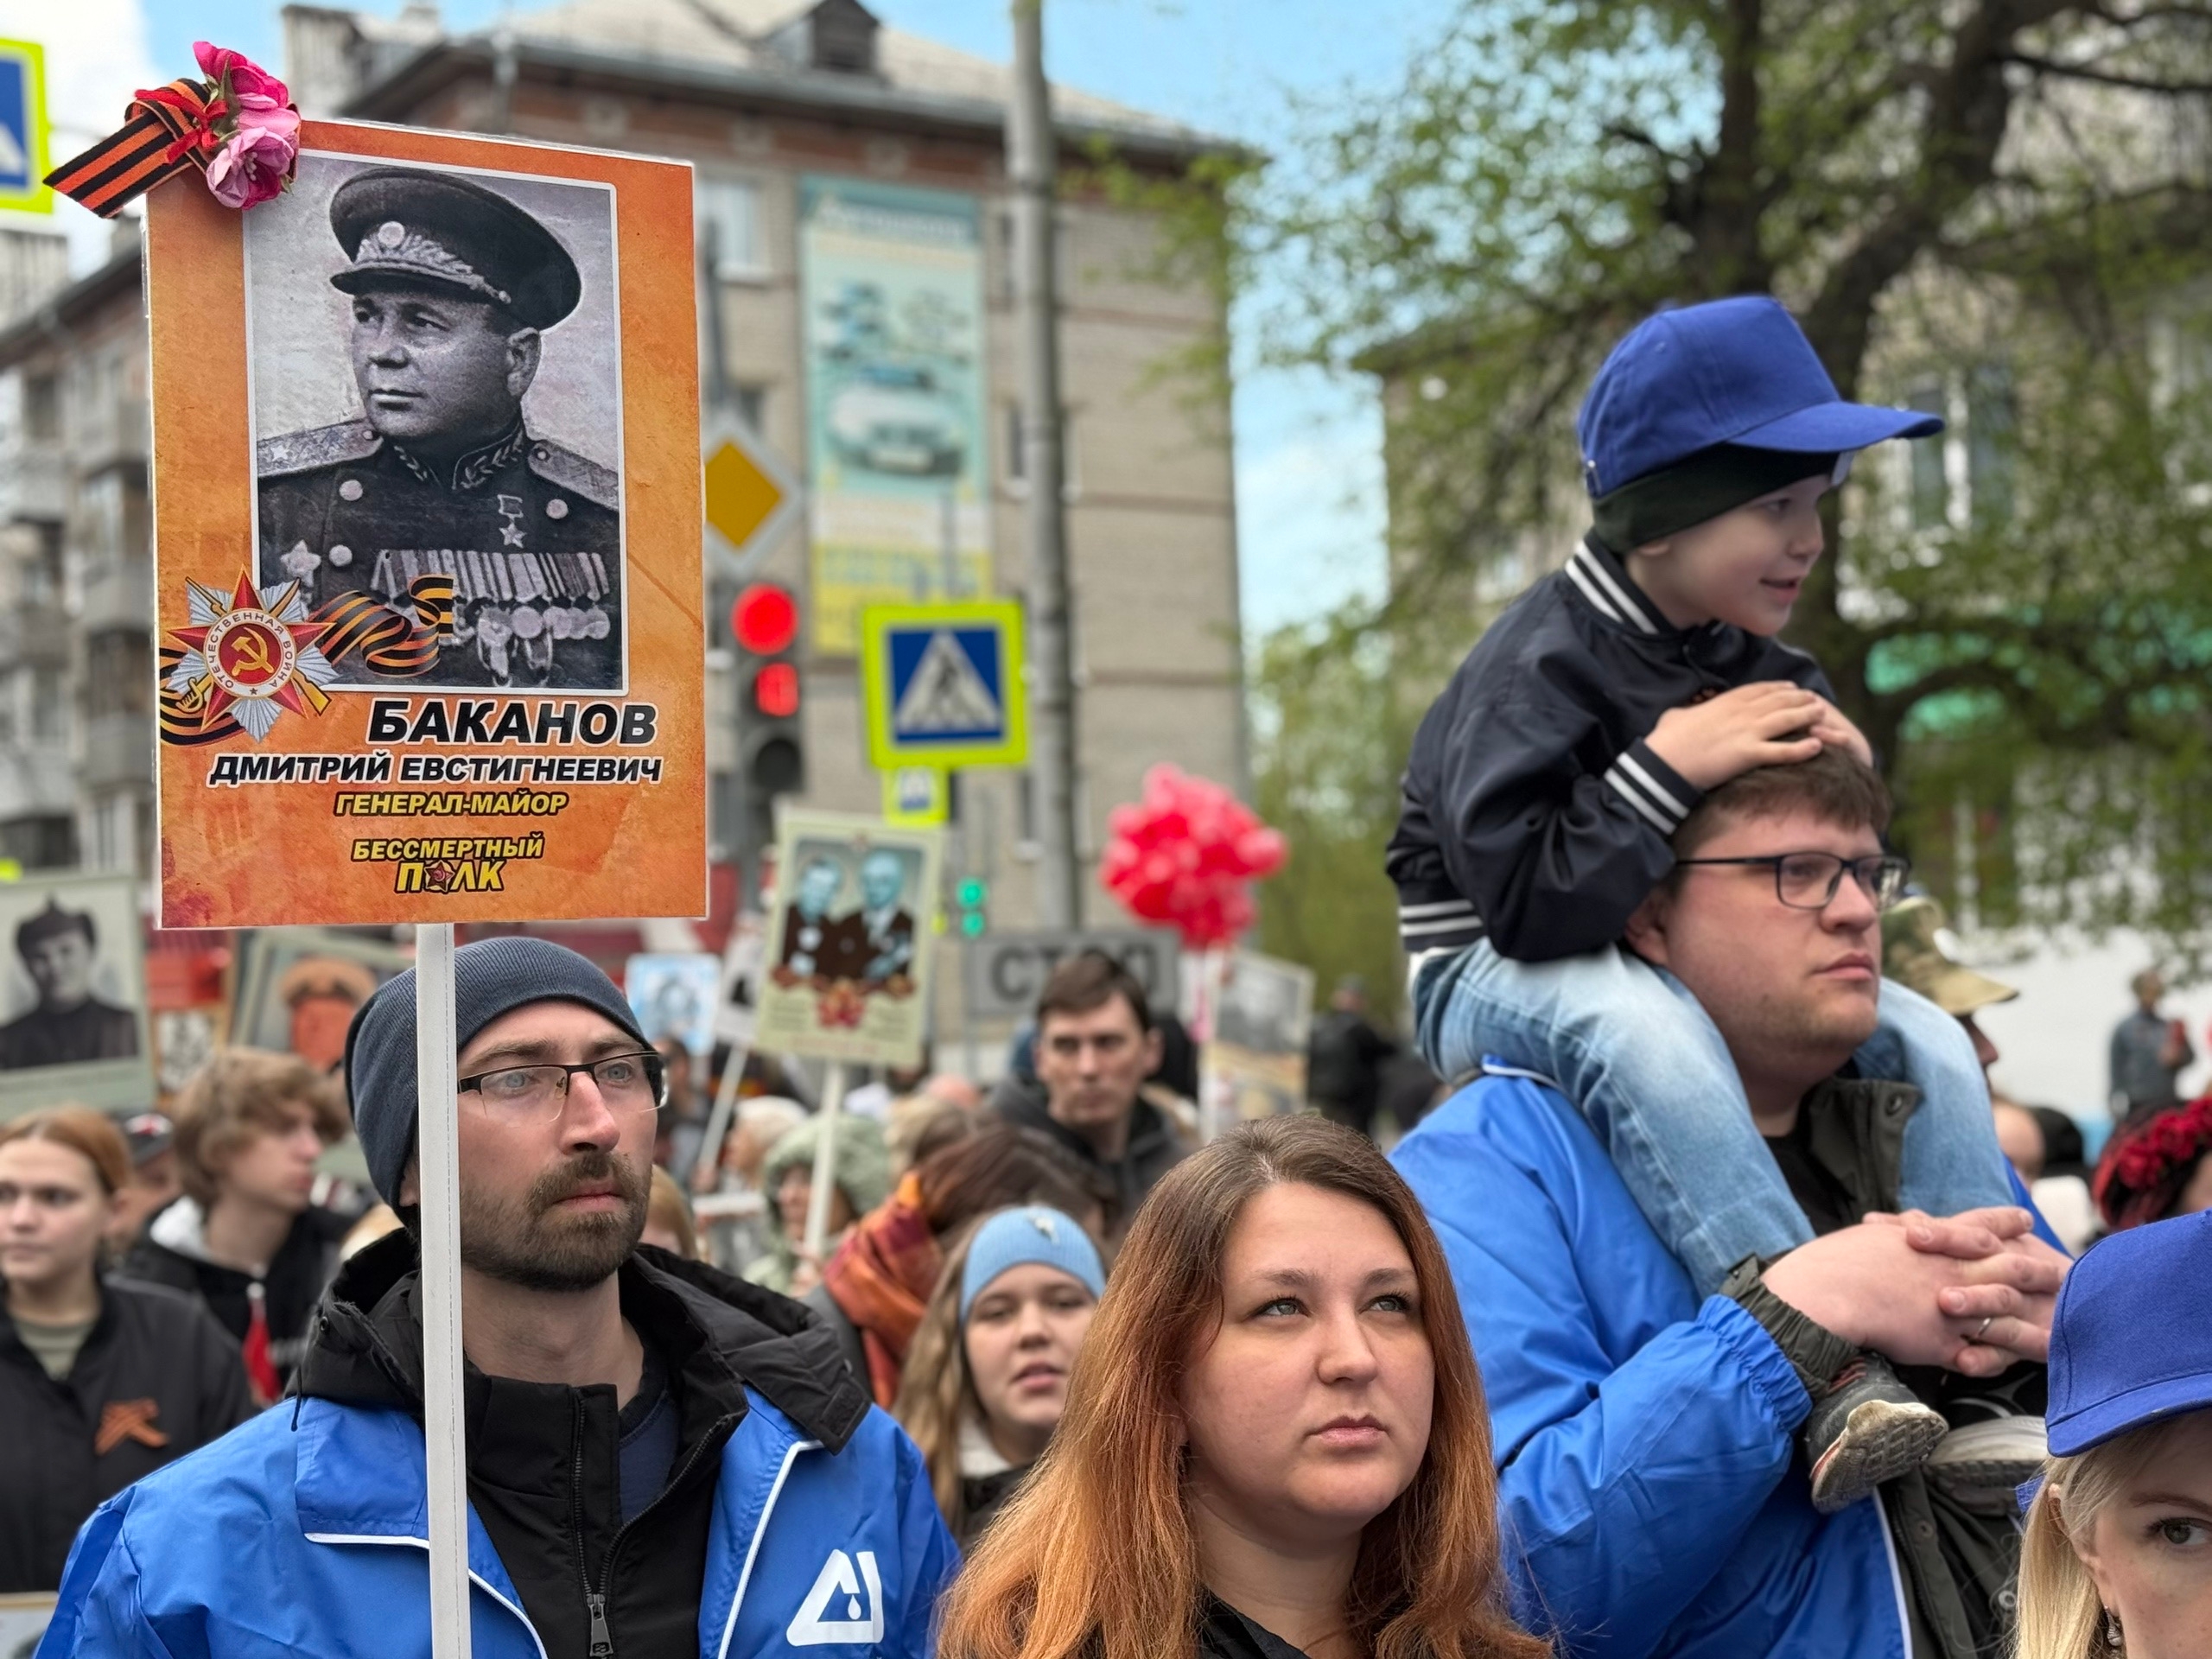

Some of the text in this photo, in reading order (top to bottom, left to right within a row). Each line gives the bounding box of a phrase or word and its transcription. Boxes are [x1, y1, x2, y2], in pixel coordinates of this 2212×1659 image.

[207, 612, 285, 689] ОТЕЧЕСТВЕННАЯ
[367, 699, 658, 746] БАКАНОВ
[208, 751, 664, 786] ДМИТРИЙ ЕВСТИГНЕЕВИЧ
[334, 789, 569, 817] ГЕНЕРАЛ-МАЙОР
[352, 832, 545, 861] БЕССМЕРТНЫЙ
